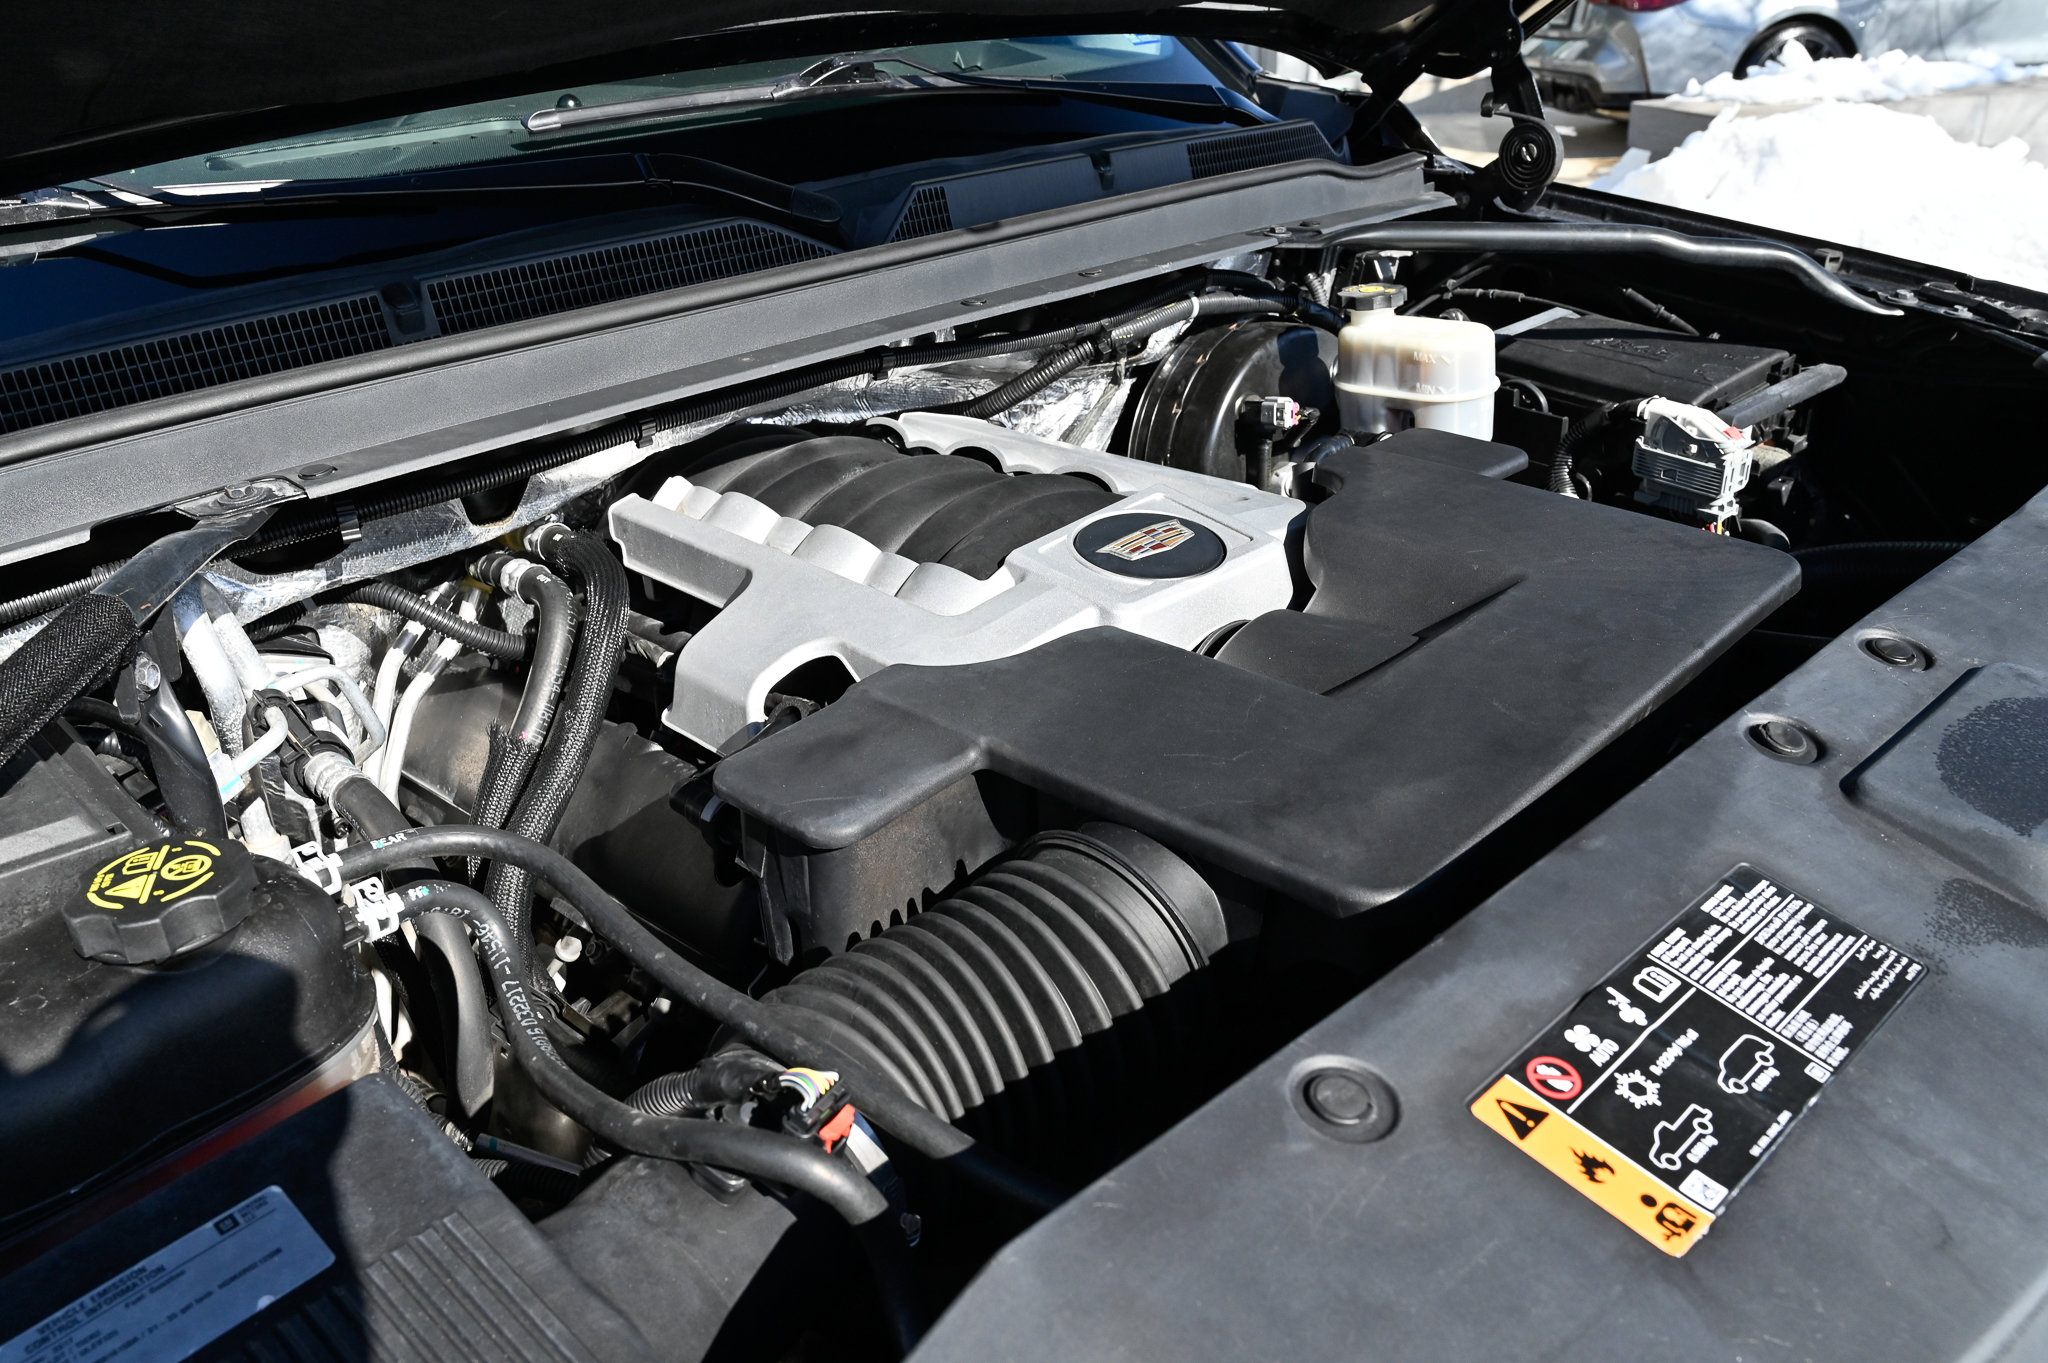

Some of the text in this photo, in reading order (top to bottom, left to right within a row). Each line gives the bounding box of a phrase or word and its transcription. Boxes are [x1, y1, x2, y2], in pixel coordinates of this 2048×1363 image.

[1413, 351, 1436, 364] MAX
[1416, 382, 1436, 395] MIN
[370, 832, 407, 850] REAR
[1589, 1039, 1620, 1067] AUTO
[24, 1316, 80, 1354] CONTROL
[83, 1264, 166, 1317] INFORMATION
[37, 1265, 147, 1335] VEHICLE EMISSION
